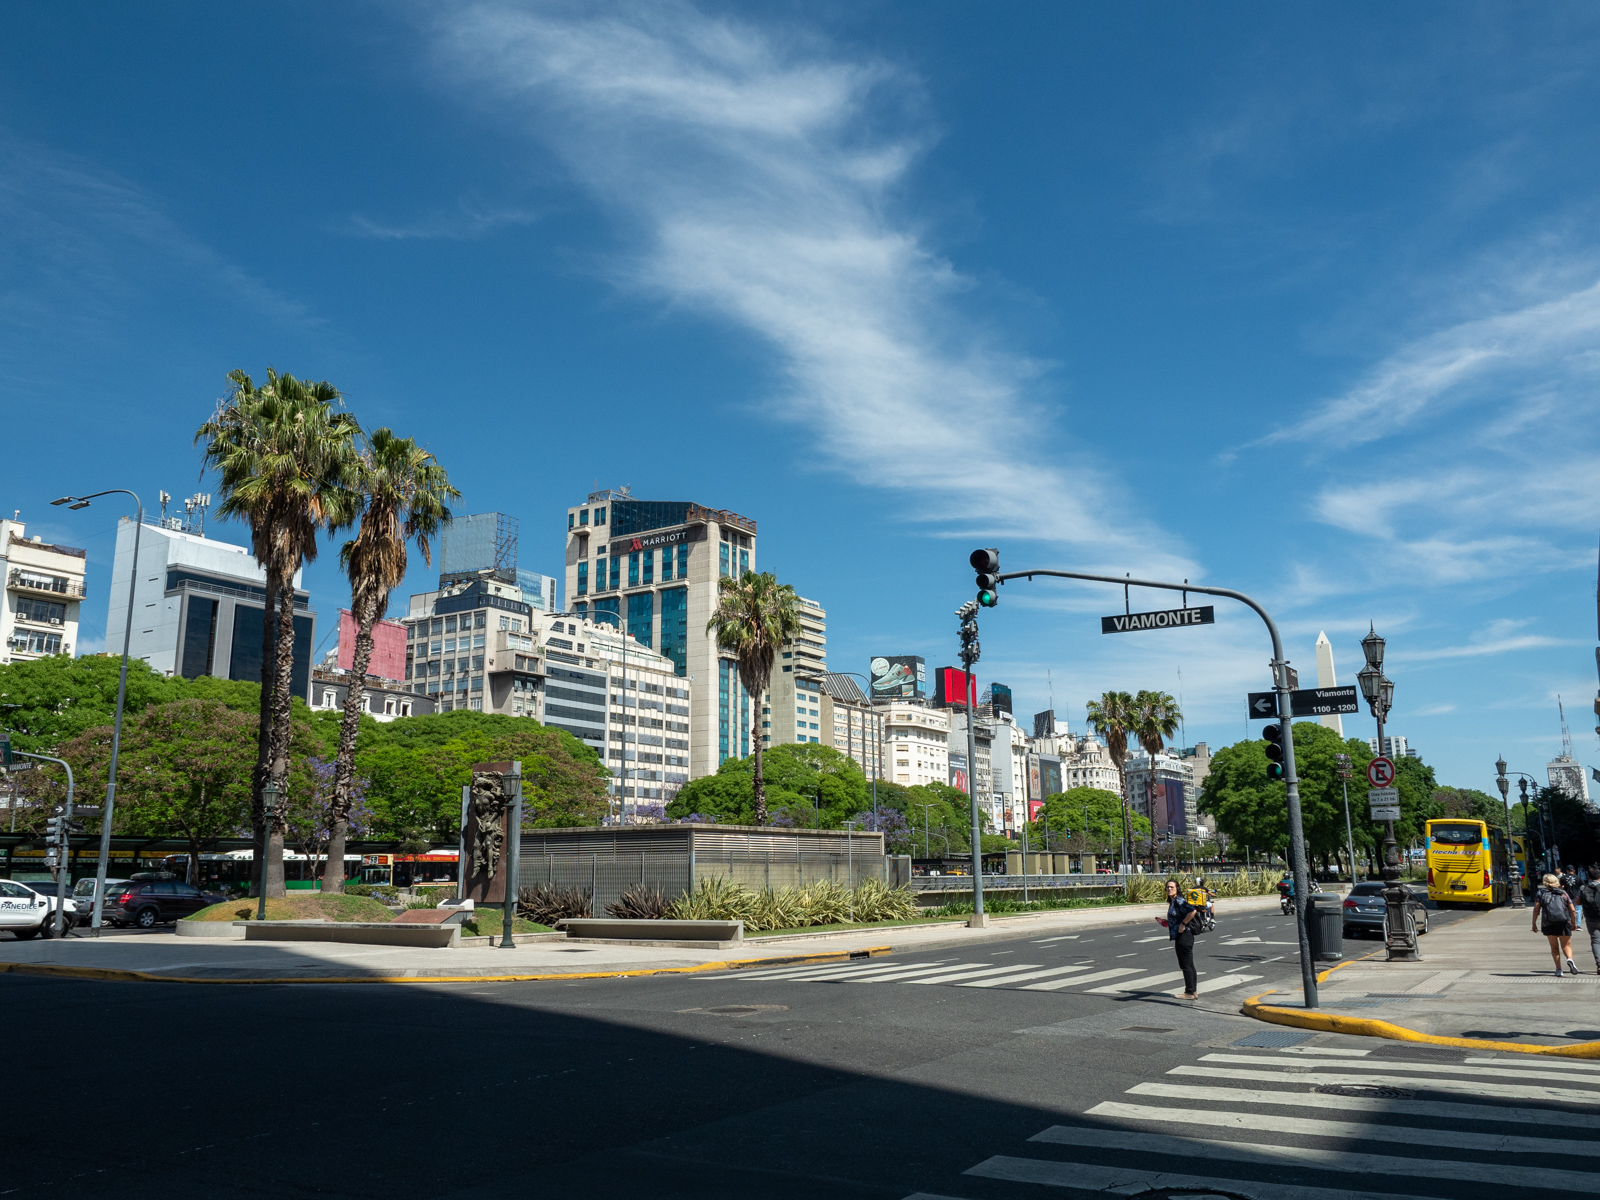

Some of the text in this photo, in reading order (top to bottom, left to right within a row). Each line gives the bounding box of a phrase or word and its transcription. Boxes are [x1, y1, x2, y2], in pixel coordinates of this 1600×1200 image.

[642, 532, 687, 546] MARRIOTT
[1113, 609, 1202, 631] VIAMONTE
[1316, 689, 1355, 698] Viamonte
[1312, 705, 1331, 714] 1100
[1337, 703, 1356, 712] 1200
[9, 762, 32, 771] VIAMONTE
[370, 856, 378, 864] 59
